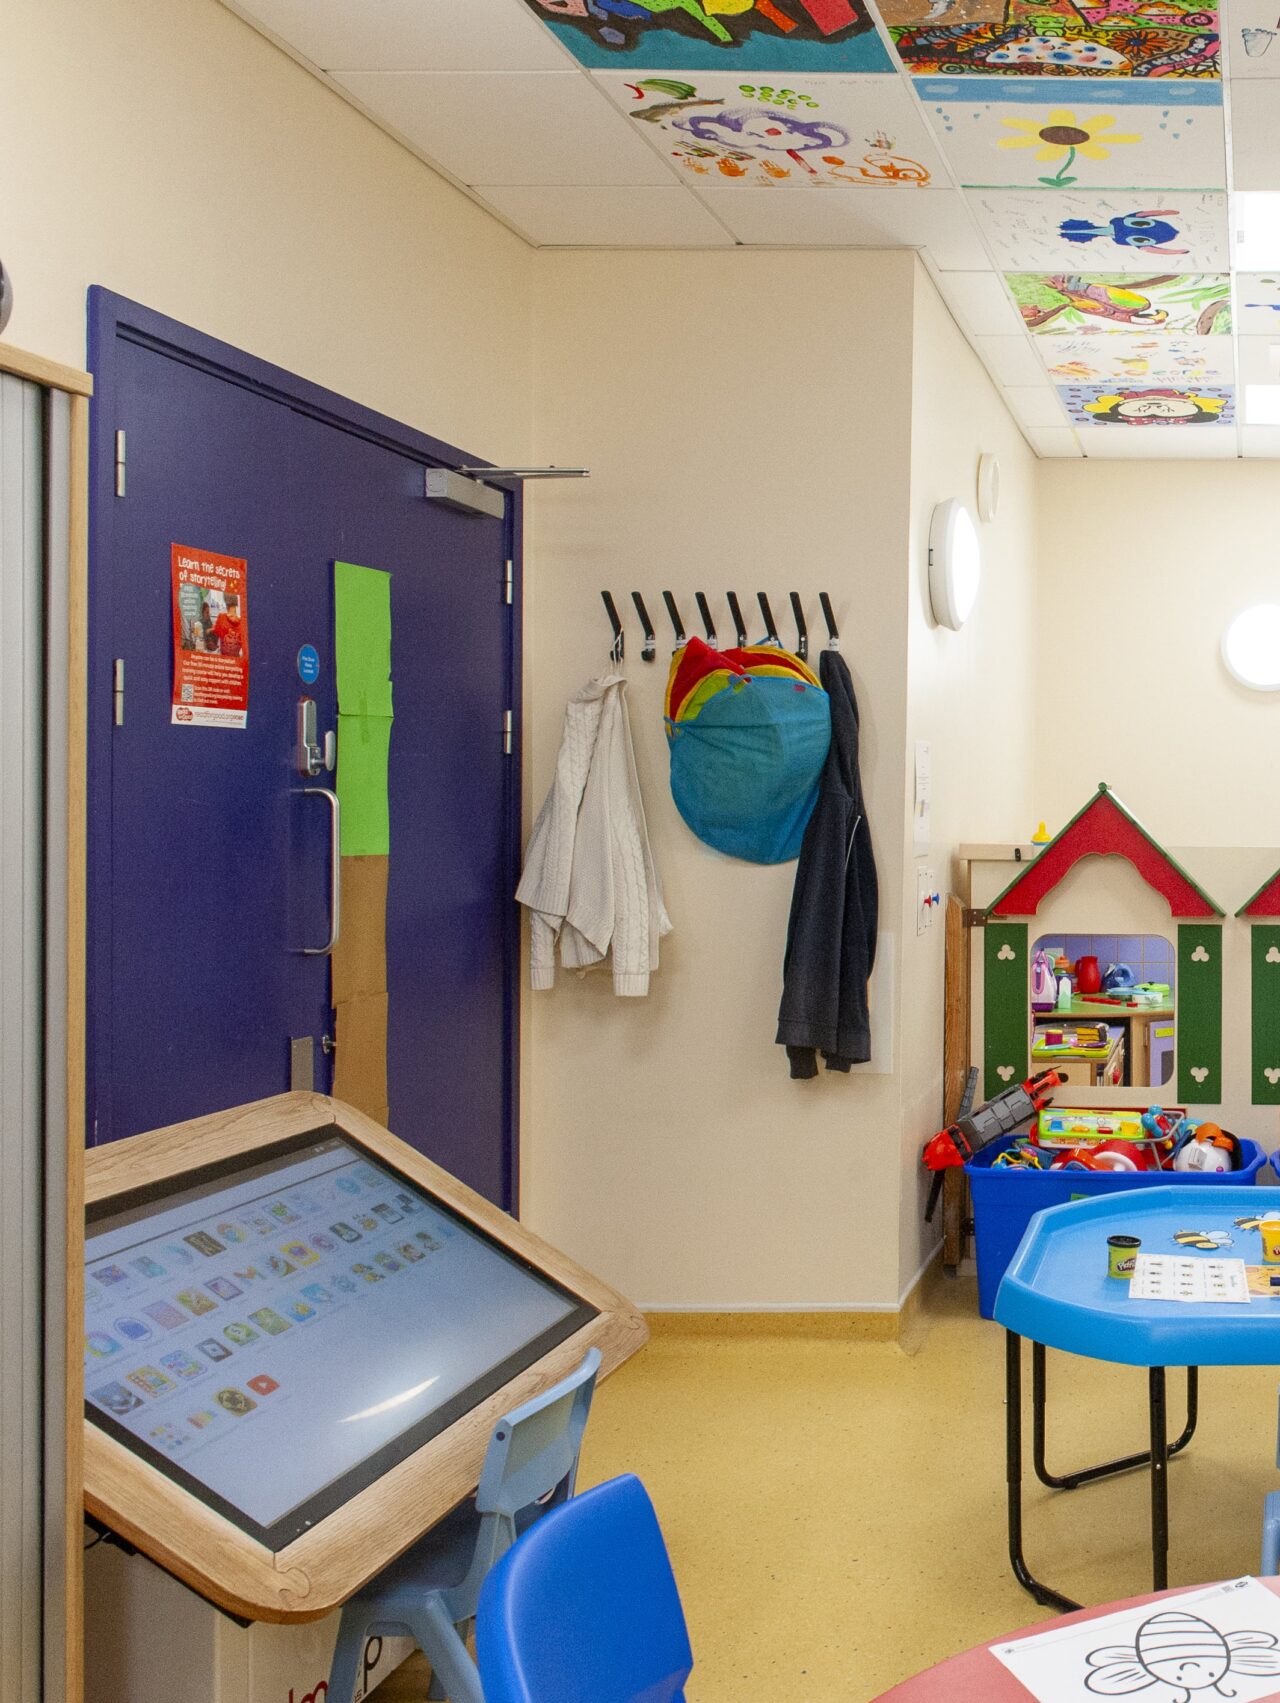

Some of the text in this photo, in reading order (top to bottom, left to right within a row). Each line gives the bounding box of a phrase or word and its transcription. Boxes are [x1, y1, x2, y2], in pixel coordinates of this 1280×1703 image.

[177, 555, 240, 579] Learn the secrets
[179, 569, 188, 581] of
